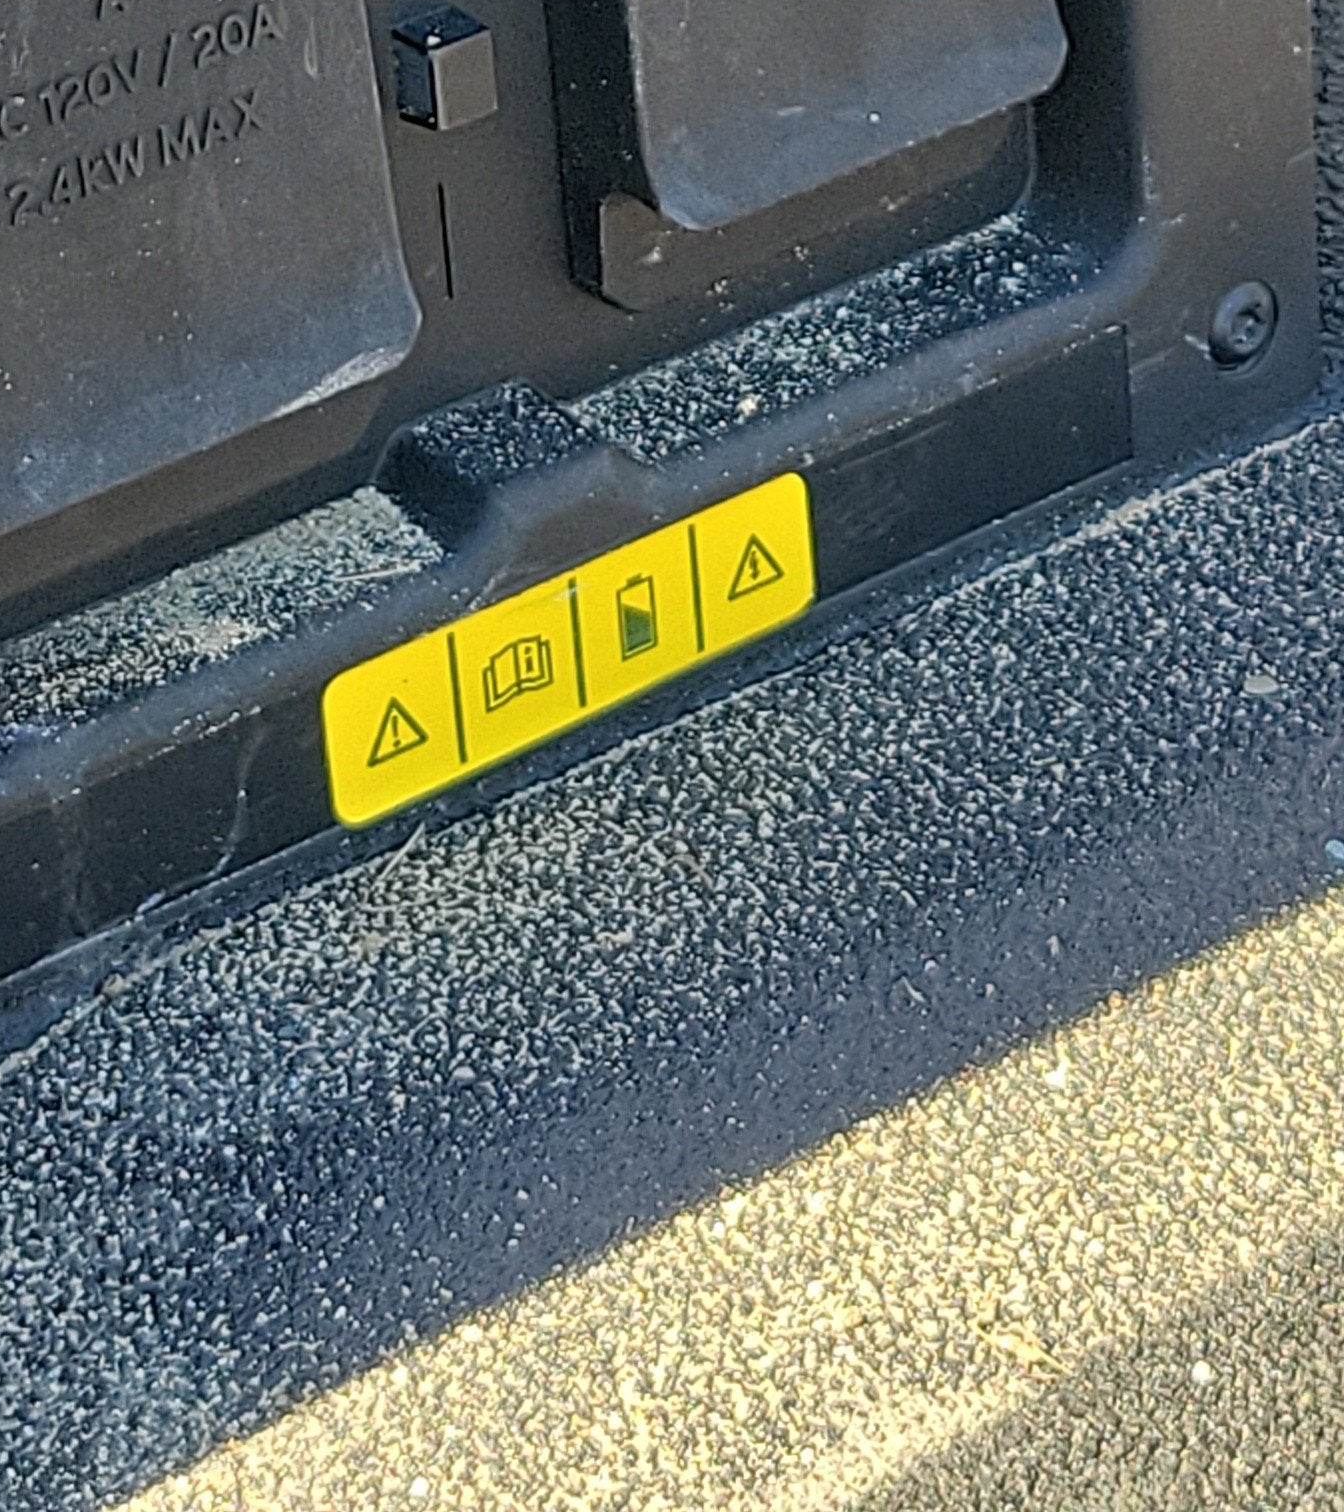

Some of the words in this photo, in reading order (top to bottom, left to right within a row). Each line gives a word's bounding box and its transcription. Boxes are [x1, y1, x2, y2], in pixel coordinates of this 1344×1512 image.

[38, 47, 144, 125] 120V
[157, 30, 178, 88] /
[190, 3, 285, 70] 20A
[157, 89, 264, 169] MAX
